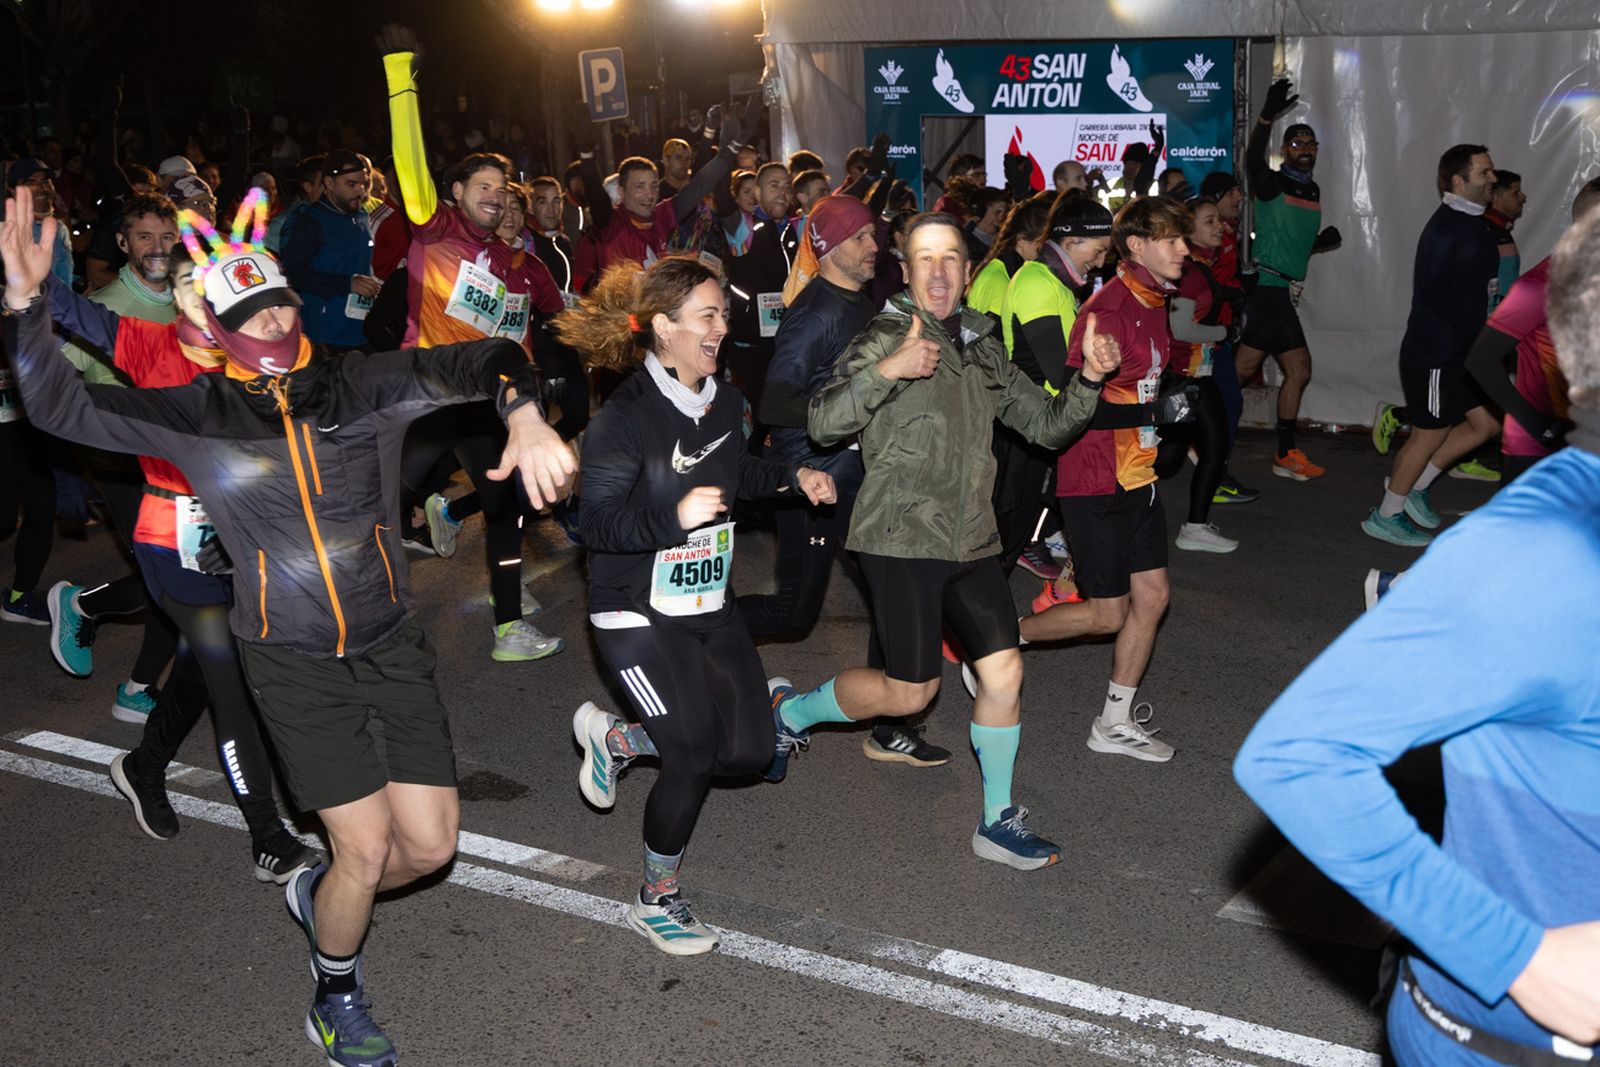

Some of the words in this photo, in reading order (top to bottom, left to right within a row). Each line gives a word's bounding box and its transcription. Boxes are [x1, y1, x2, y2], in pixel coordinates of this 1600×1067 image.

[999, 54, 1031, 81] 43
[1032, 53, 1087, 79] SAN
[590, 57, 617, 112] P
[945, 84, 961, 102] 43
[991, 75, 1082, 107] ANTÓN
[1120, 82, 1138, 101] 43
[1177, 82, 1195, 90] CAJA
[1078, 133, 1107, 142] NOCHE
[1108, 133, 1120, 141] DE
[1075, 143, 1118, 162] SAN
[464, 285, 498, 316] 8382
[702, 538, 712, 546] DE
[664, 550, 683, 562] SAN
[669, 556, 724, 587] 4509
